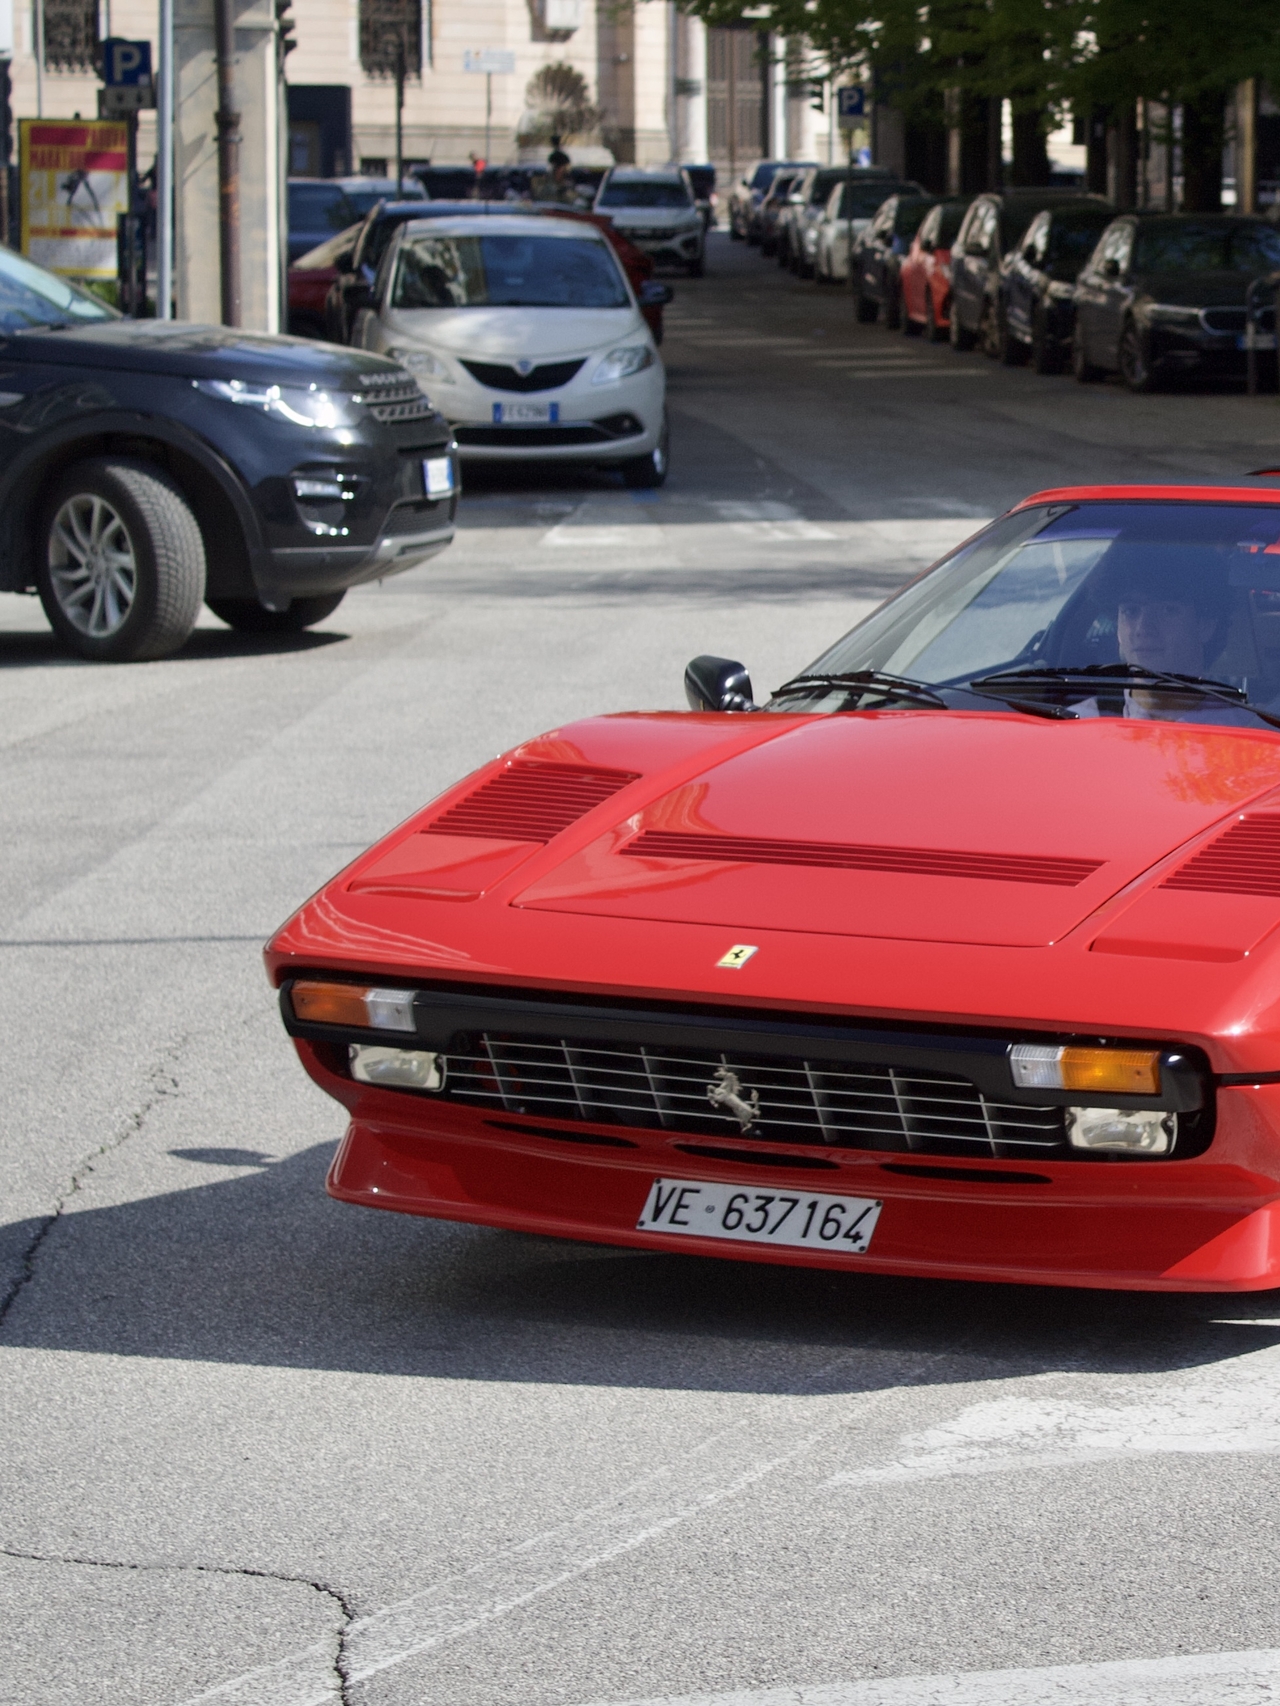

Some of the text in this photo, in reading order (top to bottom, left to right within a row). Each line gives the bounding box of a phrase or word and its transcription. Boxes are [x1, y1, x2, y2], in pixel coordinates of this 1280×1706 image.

[113, 45, 141, 81] P
[842, 90, 859, 112] P
[651, 1186, 874, 1244] VE 637164
